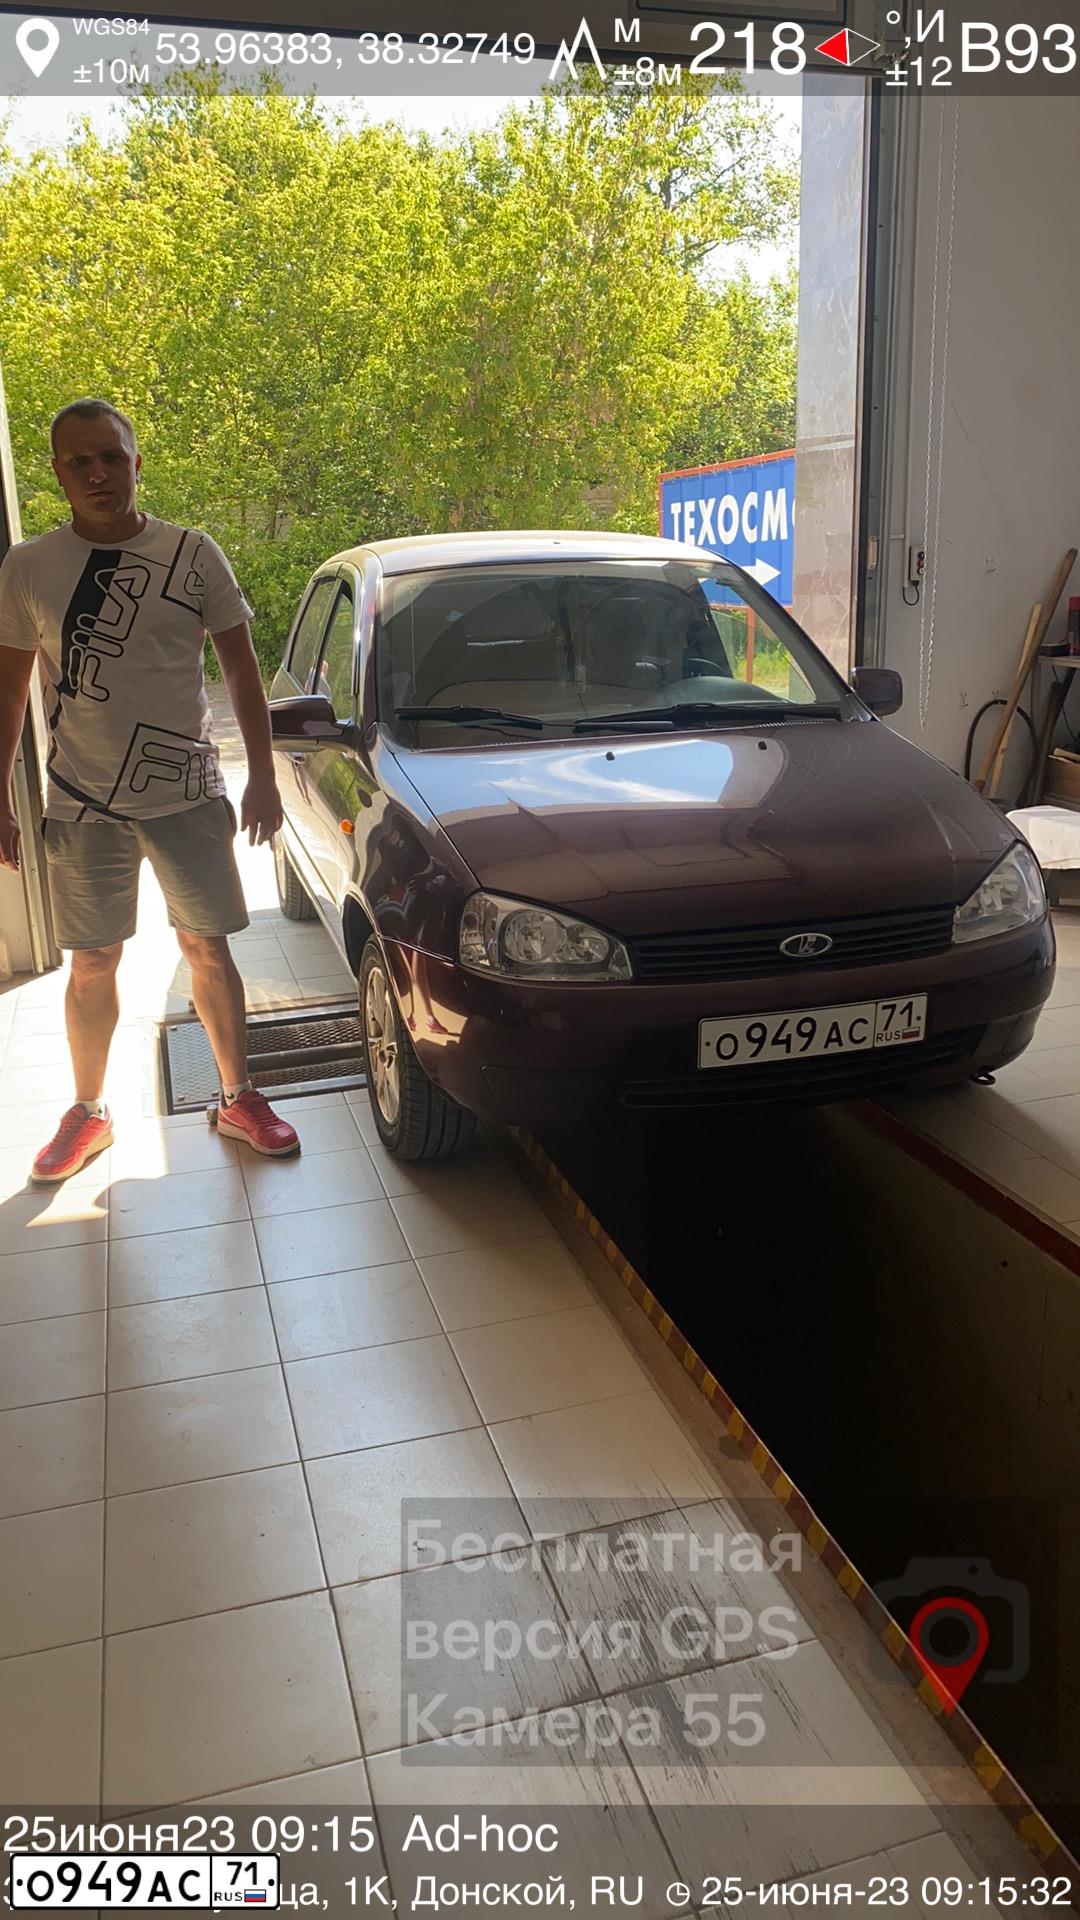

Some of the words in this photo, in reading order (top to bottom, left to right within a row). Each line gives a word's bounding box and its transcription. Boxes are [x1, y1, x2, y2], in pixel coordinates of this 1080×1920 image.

[671, 487, 796, 546] ТЕХОСМ
[67, 564, 151, 702] FILA
[876, 1030, 901, 1043] RUS
[881, 1000, 915, 1031] 71
